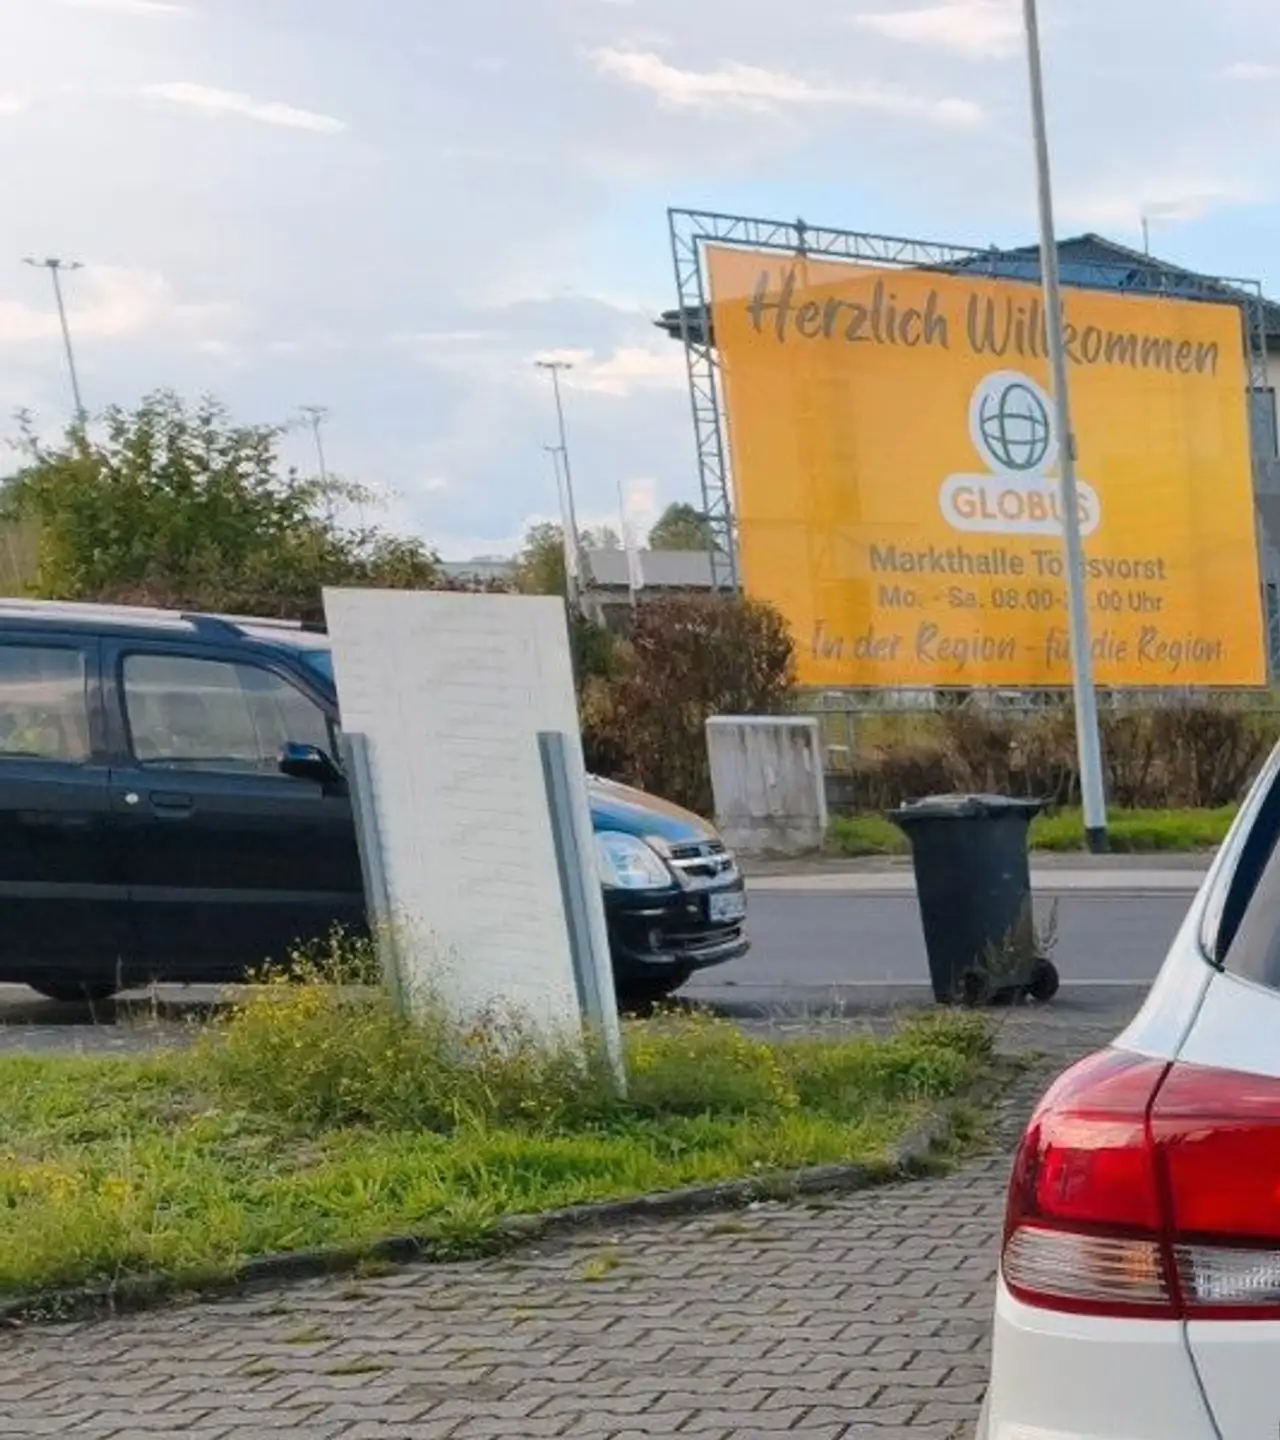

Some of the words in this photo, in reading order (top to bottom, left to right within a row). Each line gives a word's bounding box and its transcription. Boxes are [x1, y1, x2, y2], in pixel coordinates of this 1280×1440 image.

[746, 267, 950, 351] Herzlich
[965, 288, 1220, 375] Willkommen
[869, 543, 1025, 576] Markthalle
[877, 584, 924, 608] Mo.
[948, 586, 985, 610] Sa.
[1128, 589, 1164, 612] Uhr
[811, 619, 845, 659] In
[854, 624, 902, 662] der
[915, 620, 1017, 673] Region
[1091, 626, 1127, 662] die
[1137, 624, 1223, 674] Region
